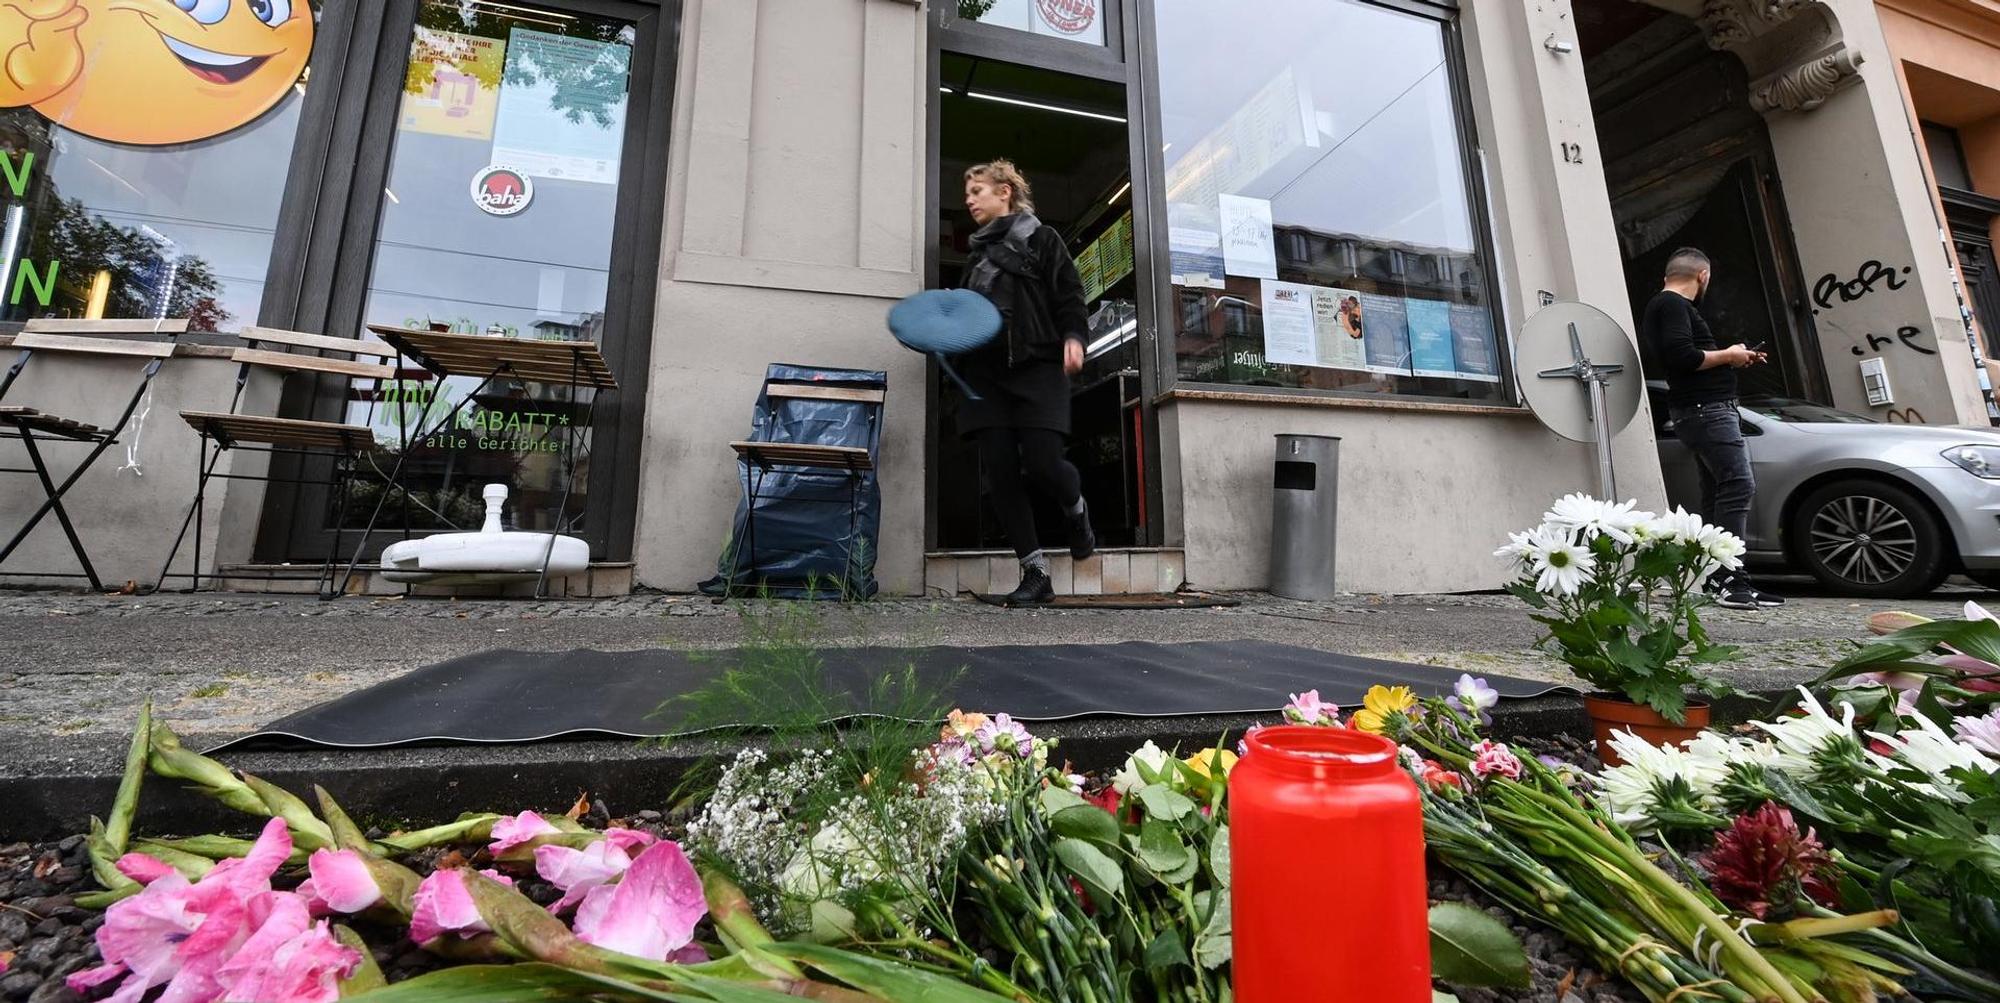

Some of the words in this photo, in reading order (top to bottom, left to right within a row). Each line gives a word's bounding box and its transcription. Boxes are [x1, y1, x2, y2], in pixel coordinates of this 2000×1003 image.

[1561, 142, 1583, 164] 12
[479, 184, 523, 206] baha
[426, 436, 467, 449] alle
